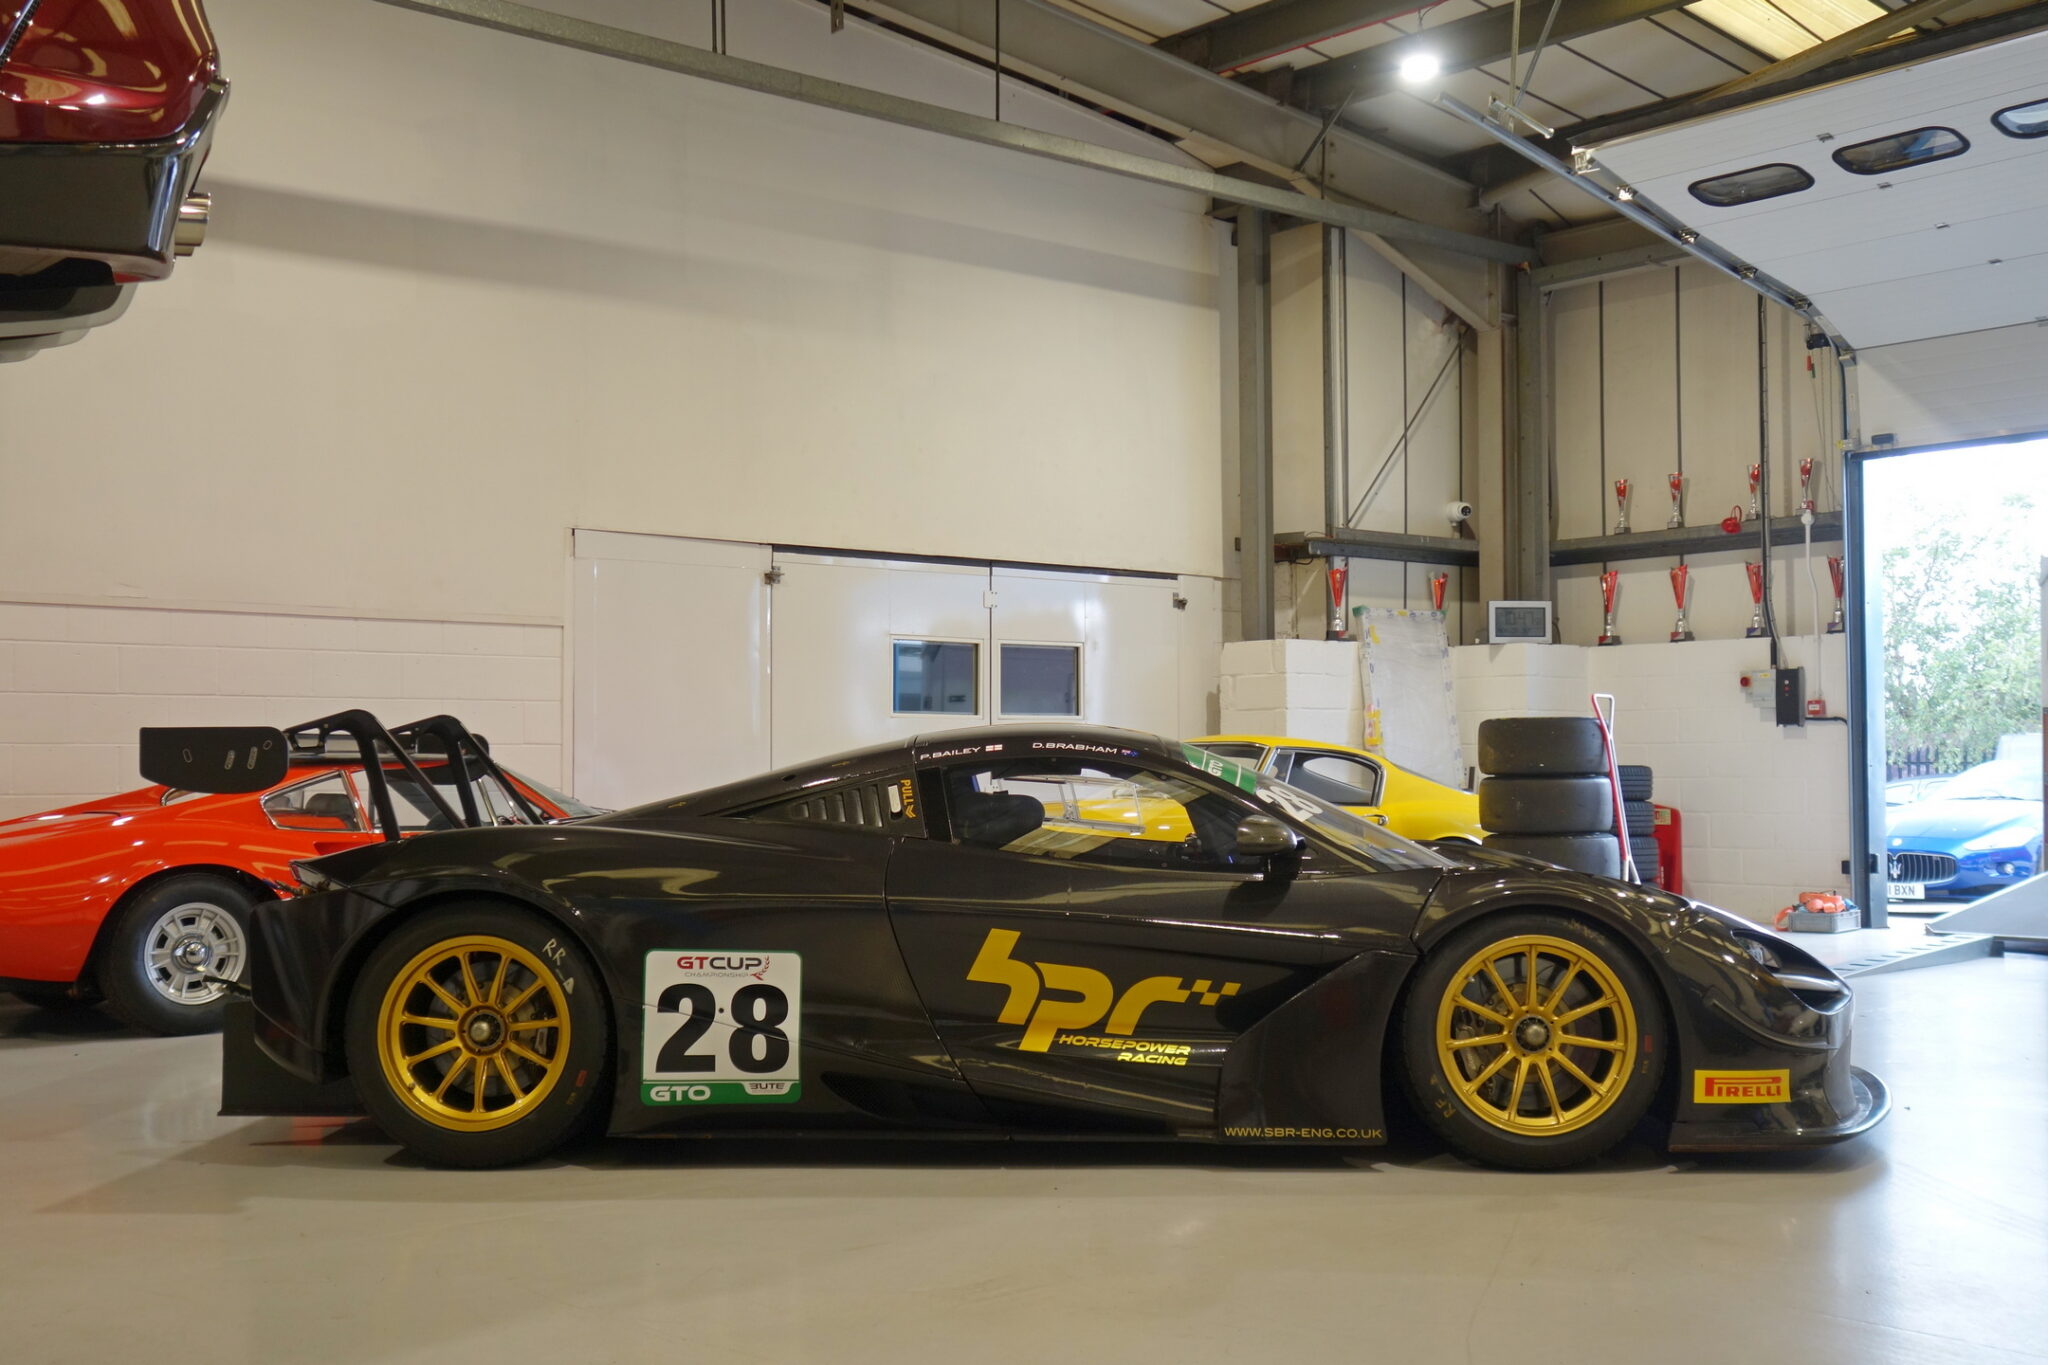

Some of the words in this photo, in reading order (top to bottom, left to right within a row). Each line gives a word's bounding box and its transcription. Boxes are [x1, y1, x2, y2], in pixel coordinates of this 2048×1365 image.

[920, 746, 981, 760] P.BAILEY
[1032, 742, 1118, 754] D.BRABHAM
[900, 779, 914, 806] PULL
[1894, 885, 1915, 896] BXN
[655, 983, 790, 1074] 28
[1059, 1034, 1192, 1056] HORSEPOWER
[1117, 1052, 1188, 1066] RACING
[650, 1085, 712, 1102] GTO
[1704, 1076, 1782, 1097] PIRELLI
[1224, 1126, 1383, 1139] WWW.SBR-ENG.CO.UK
